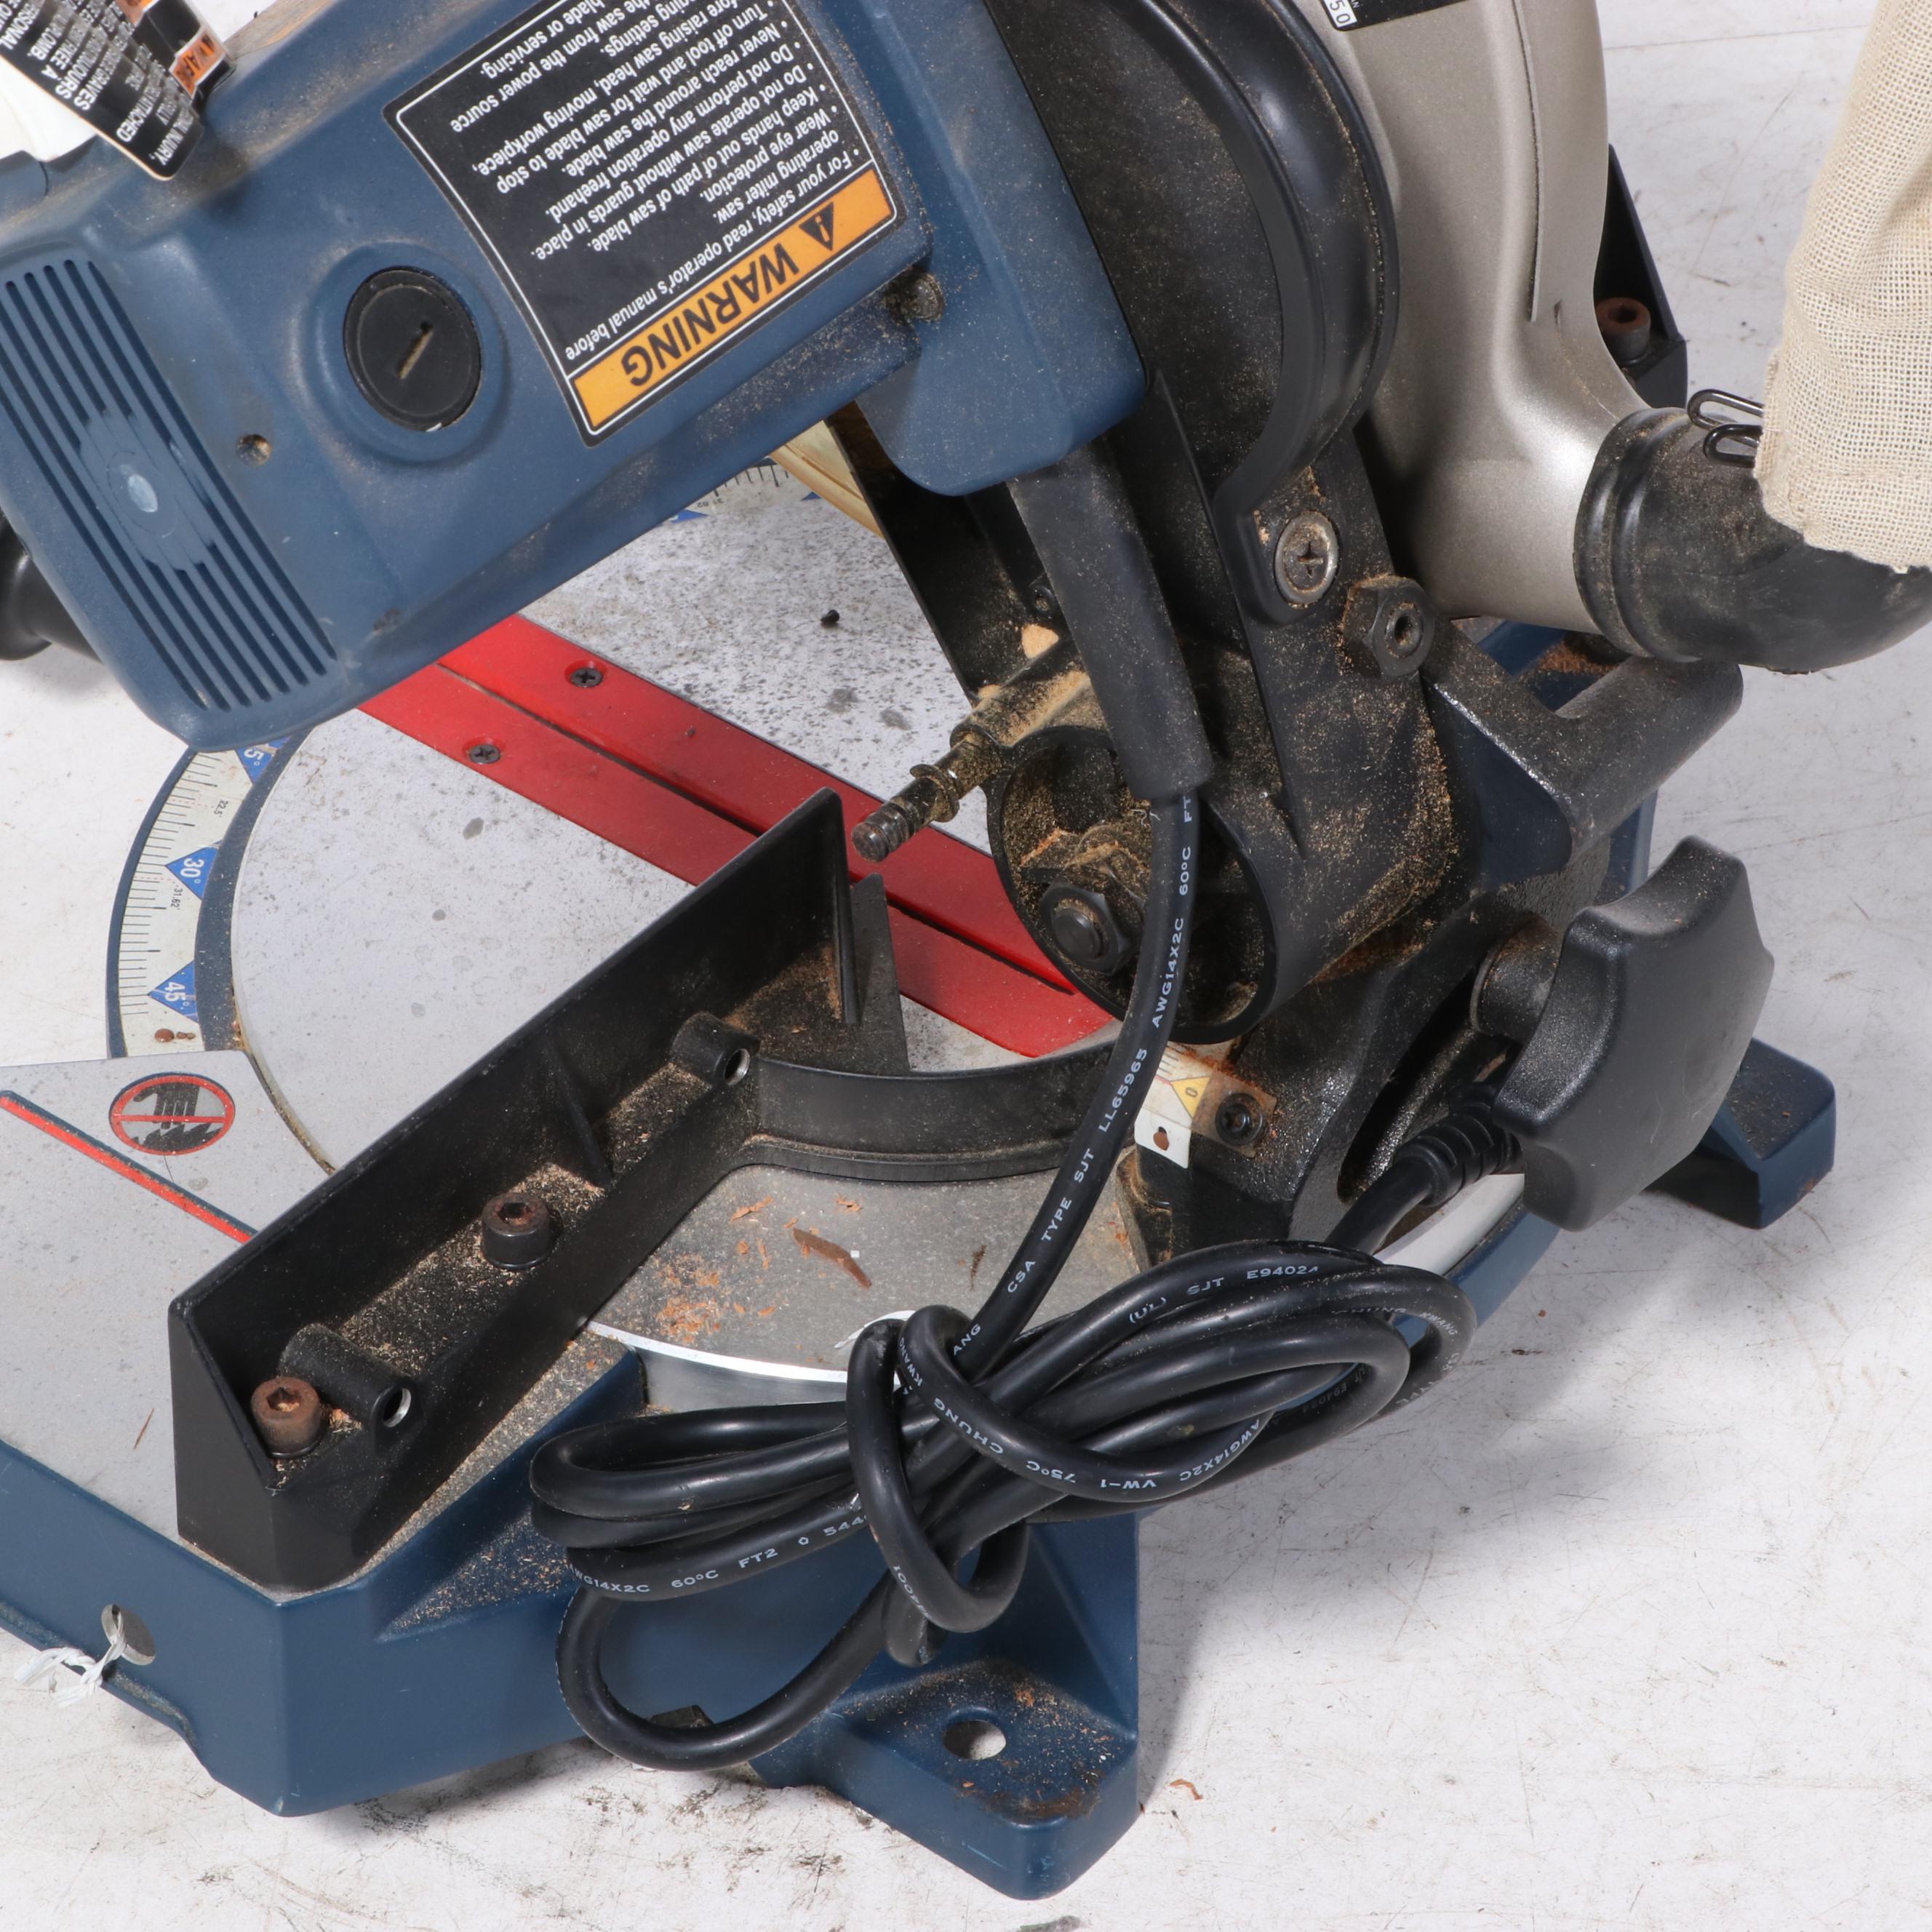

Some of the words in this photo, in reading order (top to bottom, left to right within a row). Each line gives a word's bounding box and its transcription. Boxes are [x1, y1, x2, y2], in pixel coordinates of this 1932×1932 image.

[547, 20, 564, 38] or
[596, 7, 626, 33] saw
[658, 11, 708, 49] raising
[732, 4, 768, 30] Turn
[562, 27, 599, 55] from
[600, 15, 659, 57] settings.
[685, 37, 716, 66] tool
[713, 24, 733, 49] off
[739, 23, 781, 57] Never
[480, 31, 548, 79] servicing.
[540, 49, 567, 71] the
[634, 43, 663, 69] saw
[700, 49, 740, 84] reach
[770, 44, 794, 64] Do
[498, 62, 542, 101] power
[594, 62, 637, 96] head,
[658, 56, 687, 85] and
[746, 57, 772, 84] not
[783, 65, 807, 85] Do
[610, 94, 634, 116] for
[629, 75, 662, 103] wait
[653, 76, 702, 119] around
[695, 71, 749, 117] perform
[759, 79, 784, 105] not
[781, 86, 819, 117] Keep
[450, 95, 499, 132] source
[543, 87, 598, 129] moving
[582, 109, 611, 135] saw
[631, 109, 657, 131] the
[669, 111, 696, 136] any
[711, 96, 760, 137] operate
[794, 108, 831, 140] Wear
[603, 125, 632, 151] saw
[683, 130, 711, 157] saw
[741, 110, 785, 145] hands
[472, 123, 548, 175] workpiece,
[544, 128, 586, 160] blade
[562, 144, 607, 176] blade.
[607, 129, 670, 178] operation
[716, 140, 741, 165] out
[769, 132, 794, 156] eye
[776, 129, 839, 180] operating
[529, 154, 548, 172] to
[633, 150, 685, 194] without
[671, 162, 703, 196] path
[700, 145, 770, 202] protection.
[702, 156, 718, 179] of
[827, 151, 853, 175] For
[497, 166, 530, 193] stop
[745, 172, 779, 204] miter
[797, 163, 827, 197] your
[546, 172, 611, 223] freehand.
[588, 180, 634, 223] guards
[628, 199, 657, 226] saw
[656, 188, 672, 211] of
[713, 197, 744, 224] saw.
[751, 190, 796, 225] safety,
[531, 223, 574, 260] place.
[572, 217, 591, 234] in
[587, 218, 631, 252] blade.
[722, 220, 754, 252] read
[657, 242, 722, 295] operator's
[608, 288, 658, 334] manual
[621, 243, 799, 386] WARNING
[565, 323, 611, 360] before
[1007, 1259, 1036, 1294] CSA
[1041, 1197, 1072, 1242] TYPE
[1074, 1148, 1095, 1183] SJT
[1099, 1048, 1147, 1134] LL65965
[1152, 918, 1185, 1028] AWG14X2C
[1186, 1277, 1224, 1296] SJT
[898, 1335, 924, 1388] KWANG
[933, 1397, 1004, 1456] CHUNG
[1179, 1419, 1261, 1482] AWG14X2C
[1100, 1479, 1158, 1491] VW-1
[738, 1548, 779, 1570] FT2
[823, 1515, 868, 1536] 544
